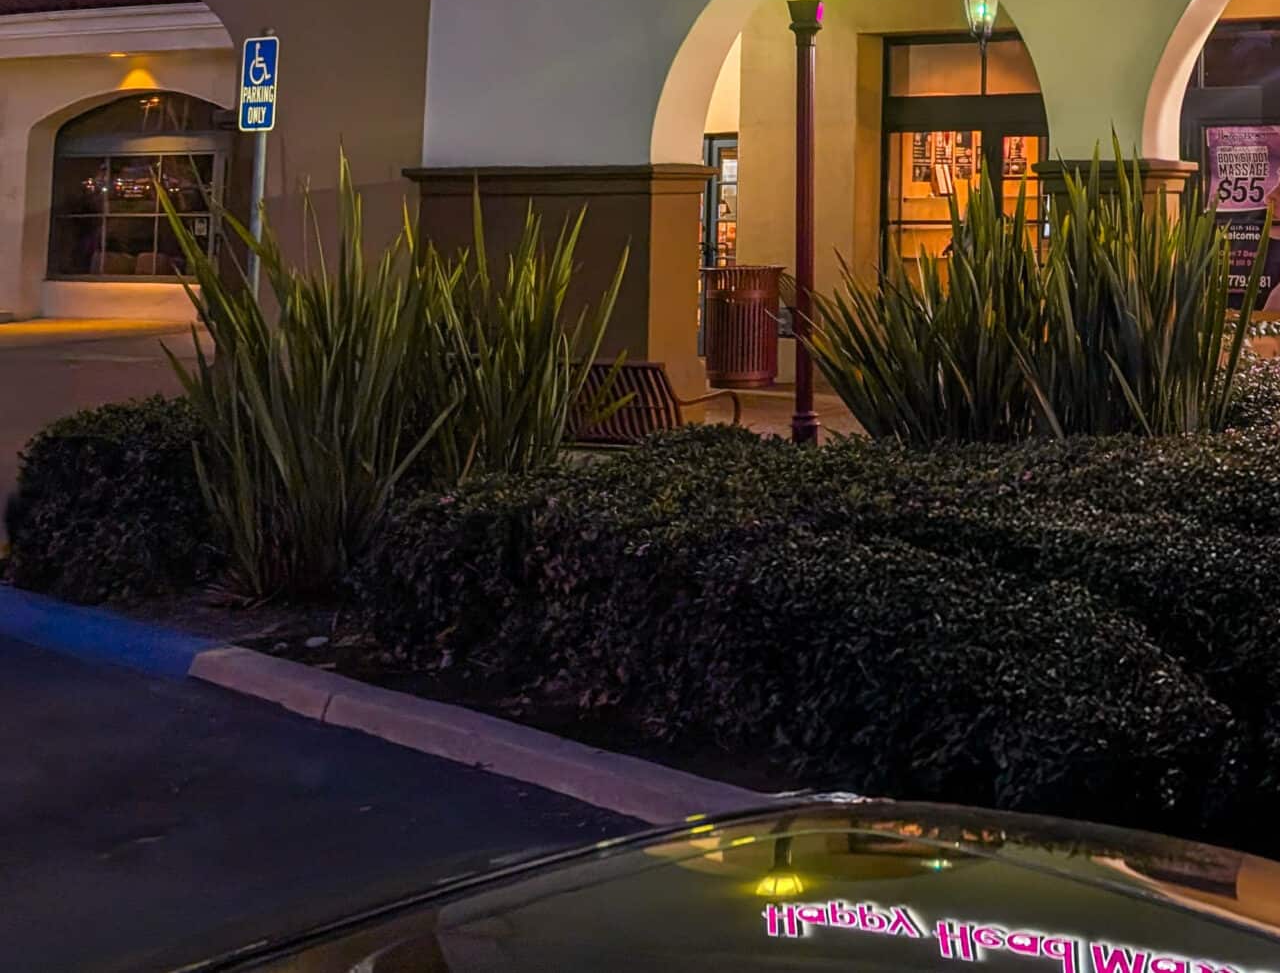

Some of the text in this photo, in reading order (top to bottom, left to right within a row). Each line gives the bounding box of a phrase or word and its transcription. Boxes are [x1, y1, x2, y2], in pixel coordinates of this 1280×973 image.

[243, 86, 274, 102] PARKING
[247, 107, 267, 124] ONLY
[1219, 163, 1268, 177] MASSAGE
[1218, 177, 1265, 202] $55
